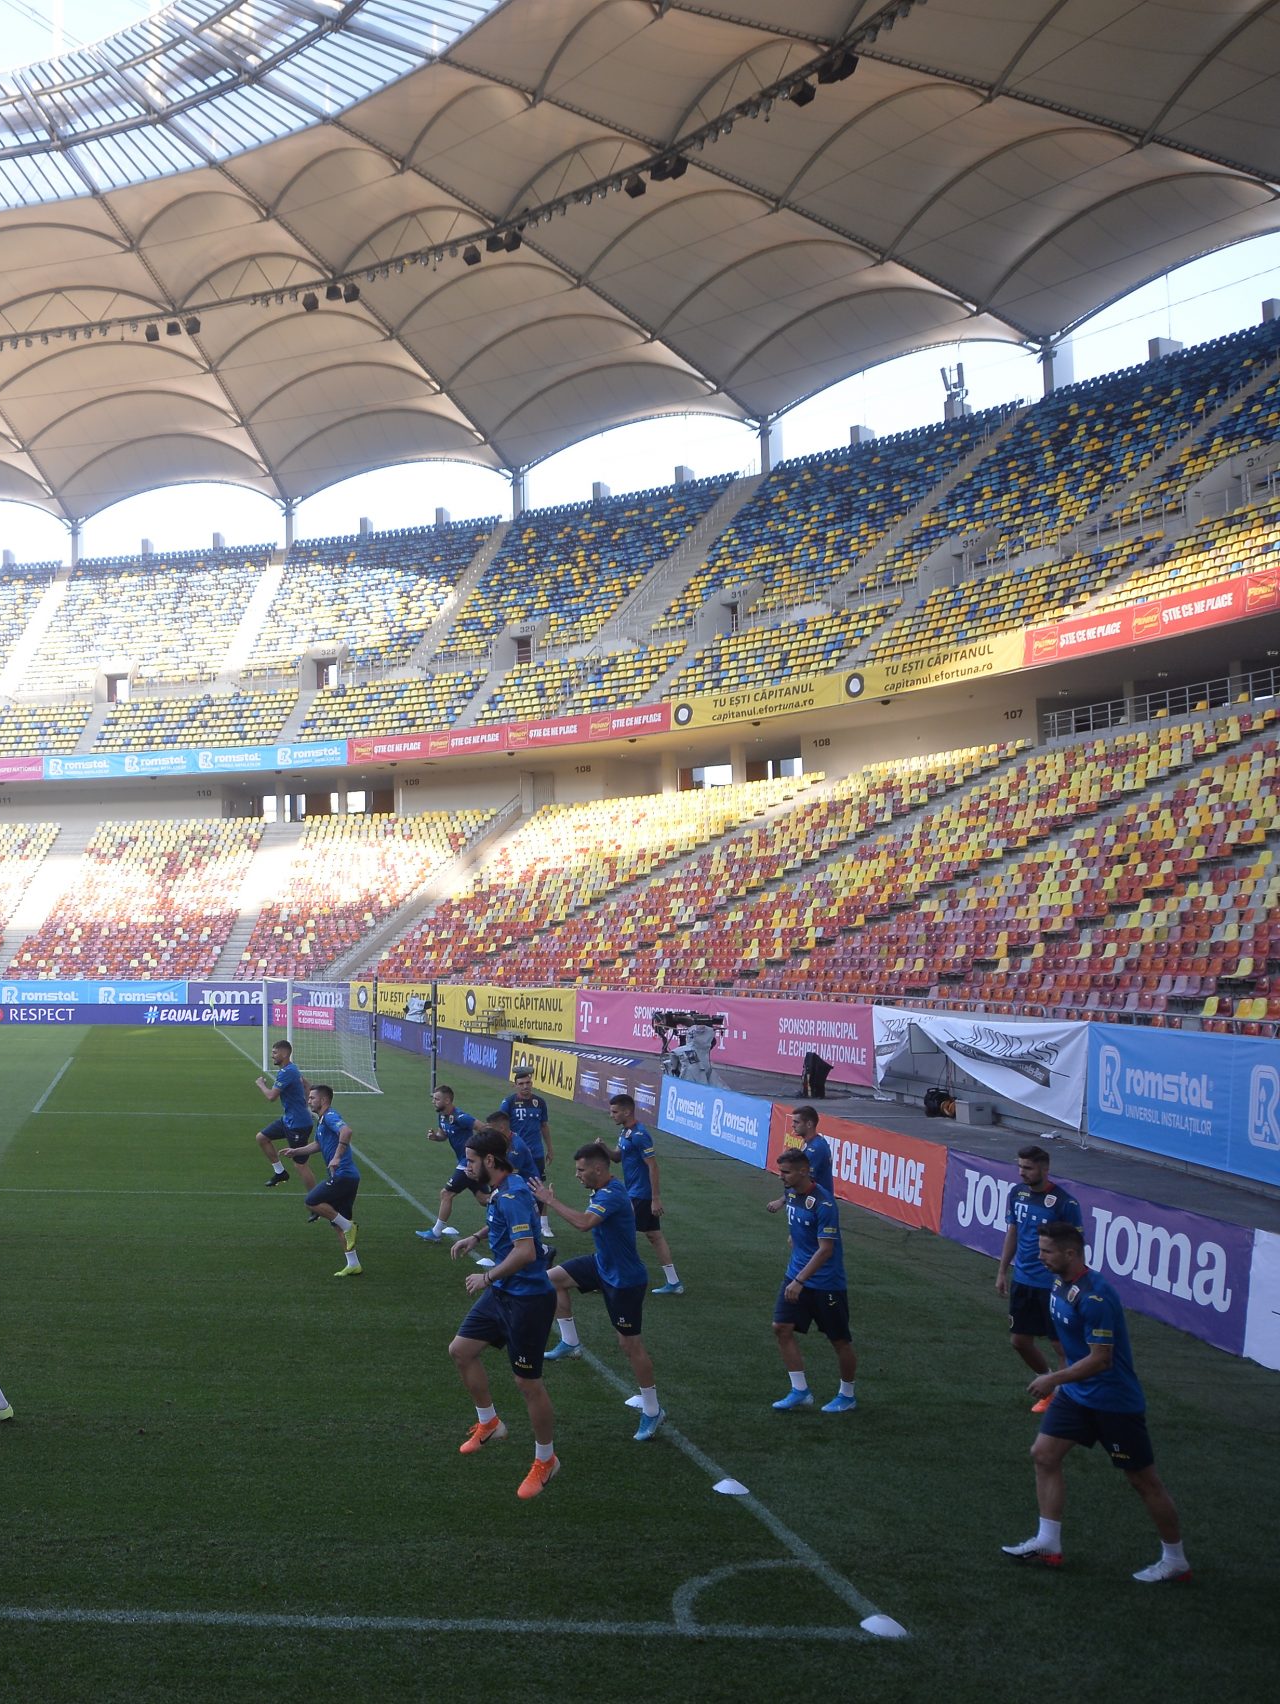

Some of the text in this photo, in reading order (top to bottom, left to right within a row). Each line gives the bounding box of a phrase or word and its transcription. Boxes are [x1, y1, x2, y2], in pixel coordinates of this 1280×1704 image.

[884, 662, 993, 692] capitanul.efortuna.ro
[885, 665, 899, 677] TU
[713, 697, 726, 709] TU
[711, 698, 814, 722] capitanul.efortuna.ro
[1004, 709, 1023, 720] 107
[813, 738, 831, 748] 108
[575, 765, 591, 774] 108
[196, 789, 212, 797] 110
[379, 990, 389, 1002] TU
[487, 995, 497, 1009] TU
[9, 1008, 75, 1021] RESPECT
[778, 1017, 815, 1036] SPONSOR
[816, 1020, 858, 1040] PRINCIPAL
[777, 1039, 787, 1055] AL
[1125, 1066, 1214, 1110] romstal
[1125, 1107, 1160, 1125] UNIVERSUL
[840, 1140, 925, 1207] CE NE PLACE
